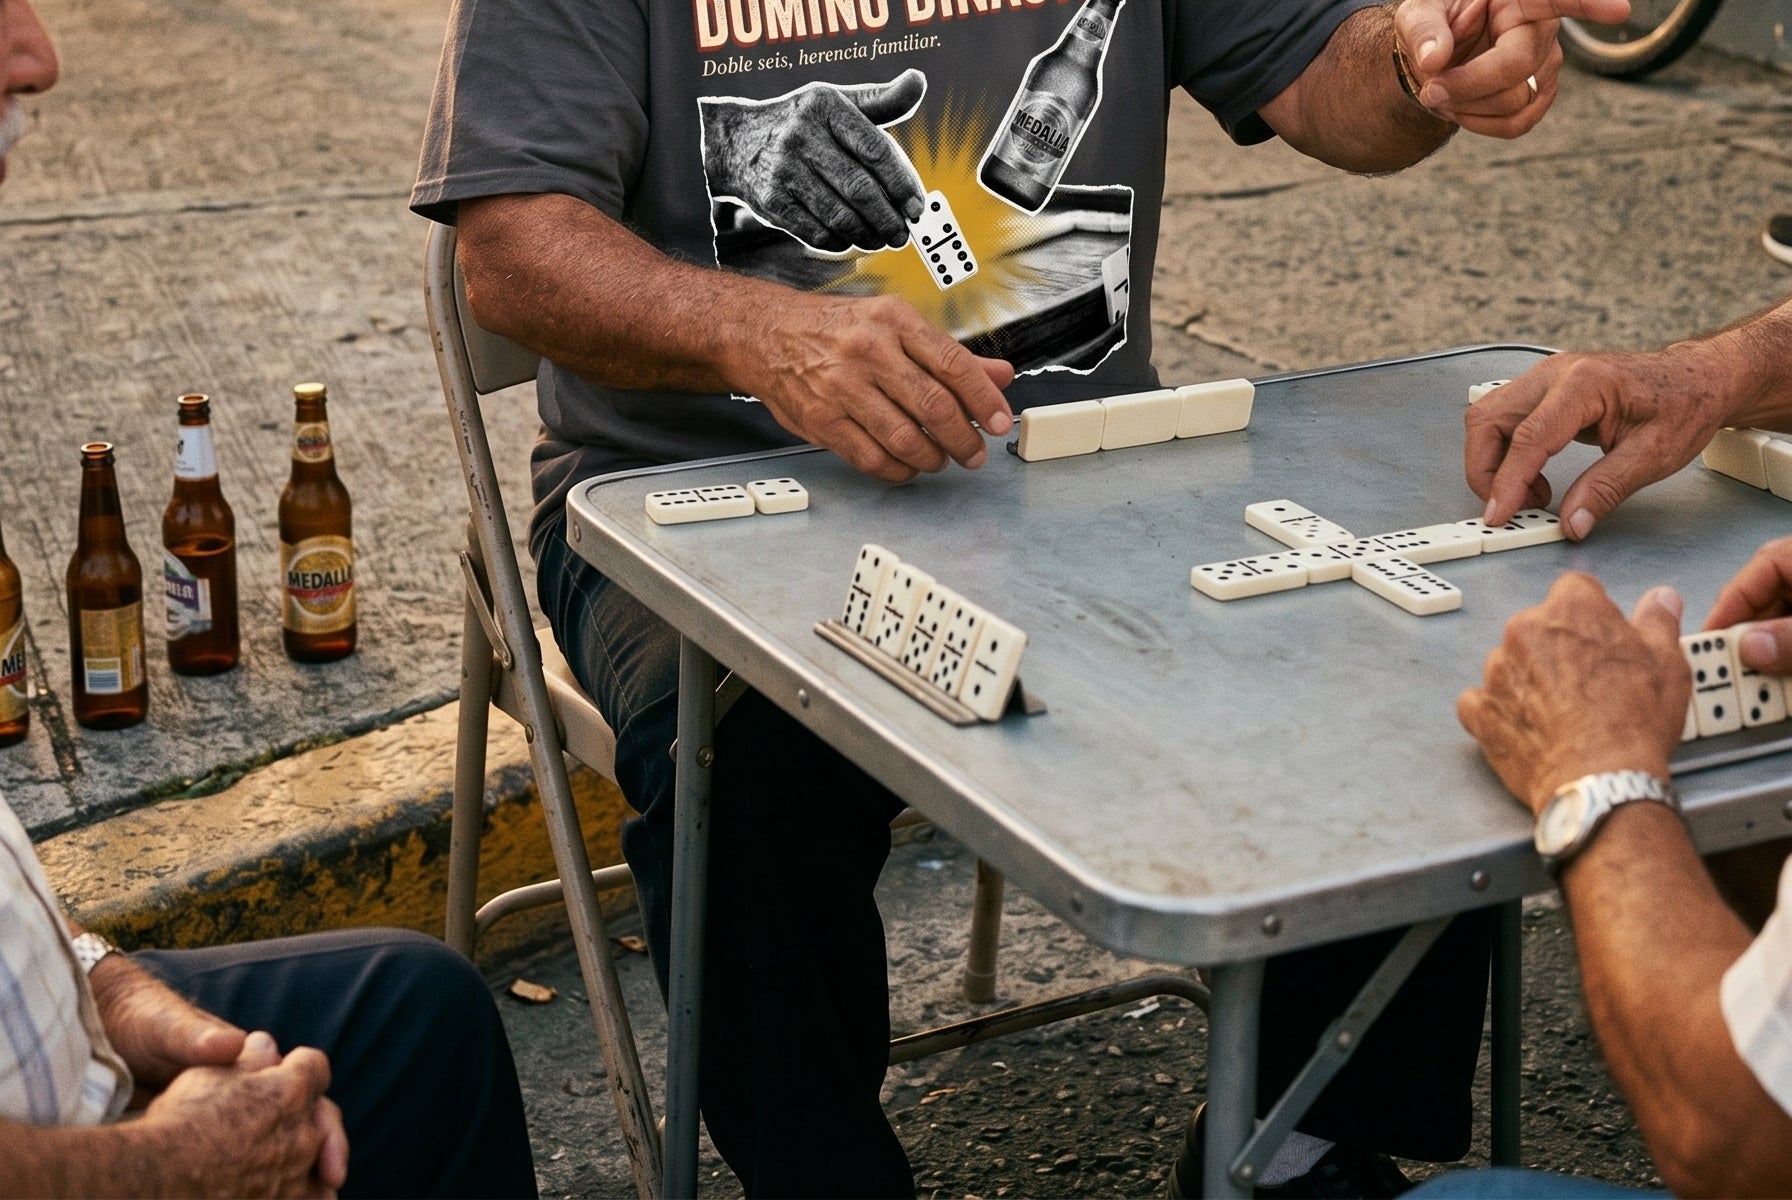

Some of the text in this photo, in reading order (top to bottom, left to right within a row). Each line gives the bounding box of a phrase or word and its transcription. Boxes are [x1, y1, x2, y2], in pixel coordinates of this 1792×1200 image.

[702, 33, 942, 77] Doble seis, herencia familiar.
